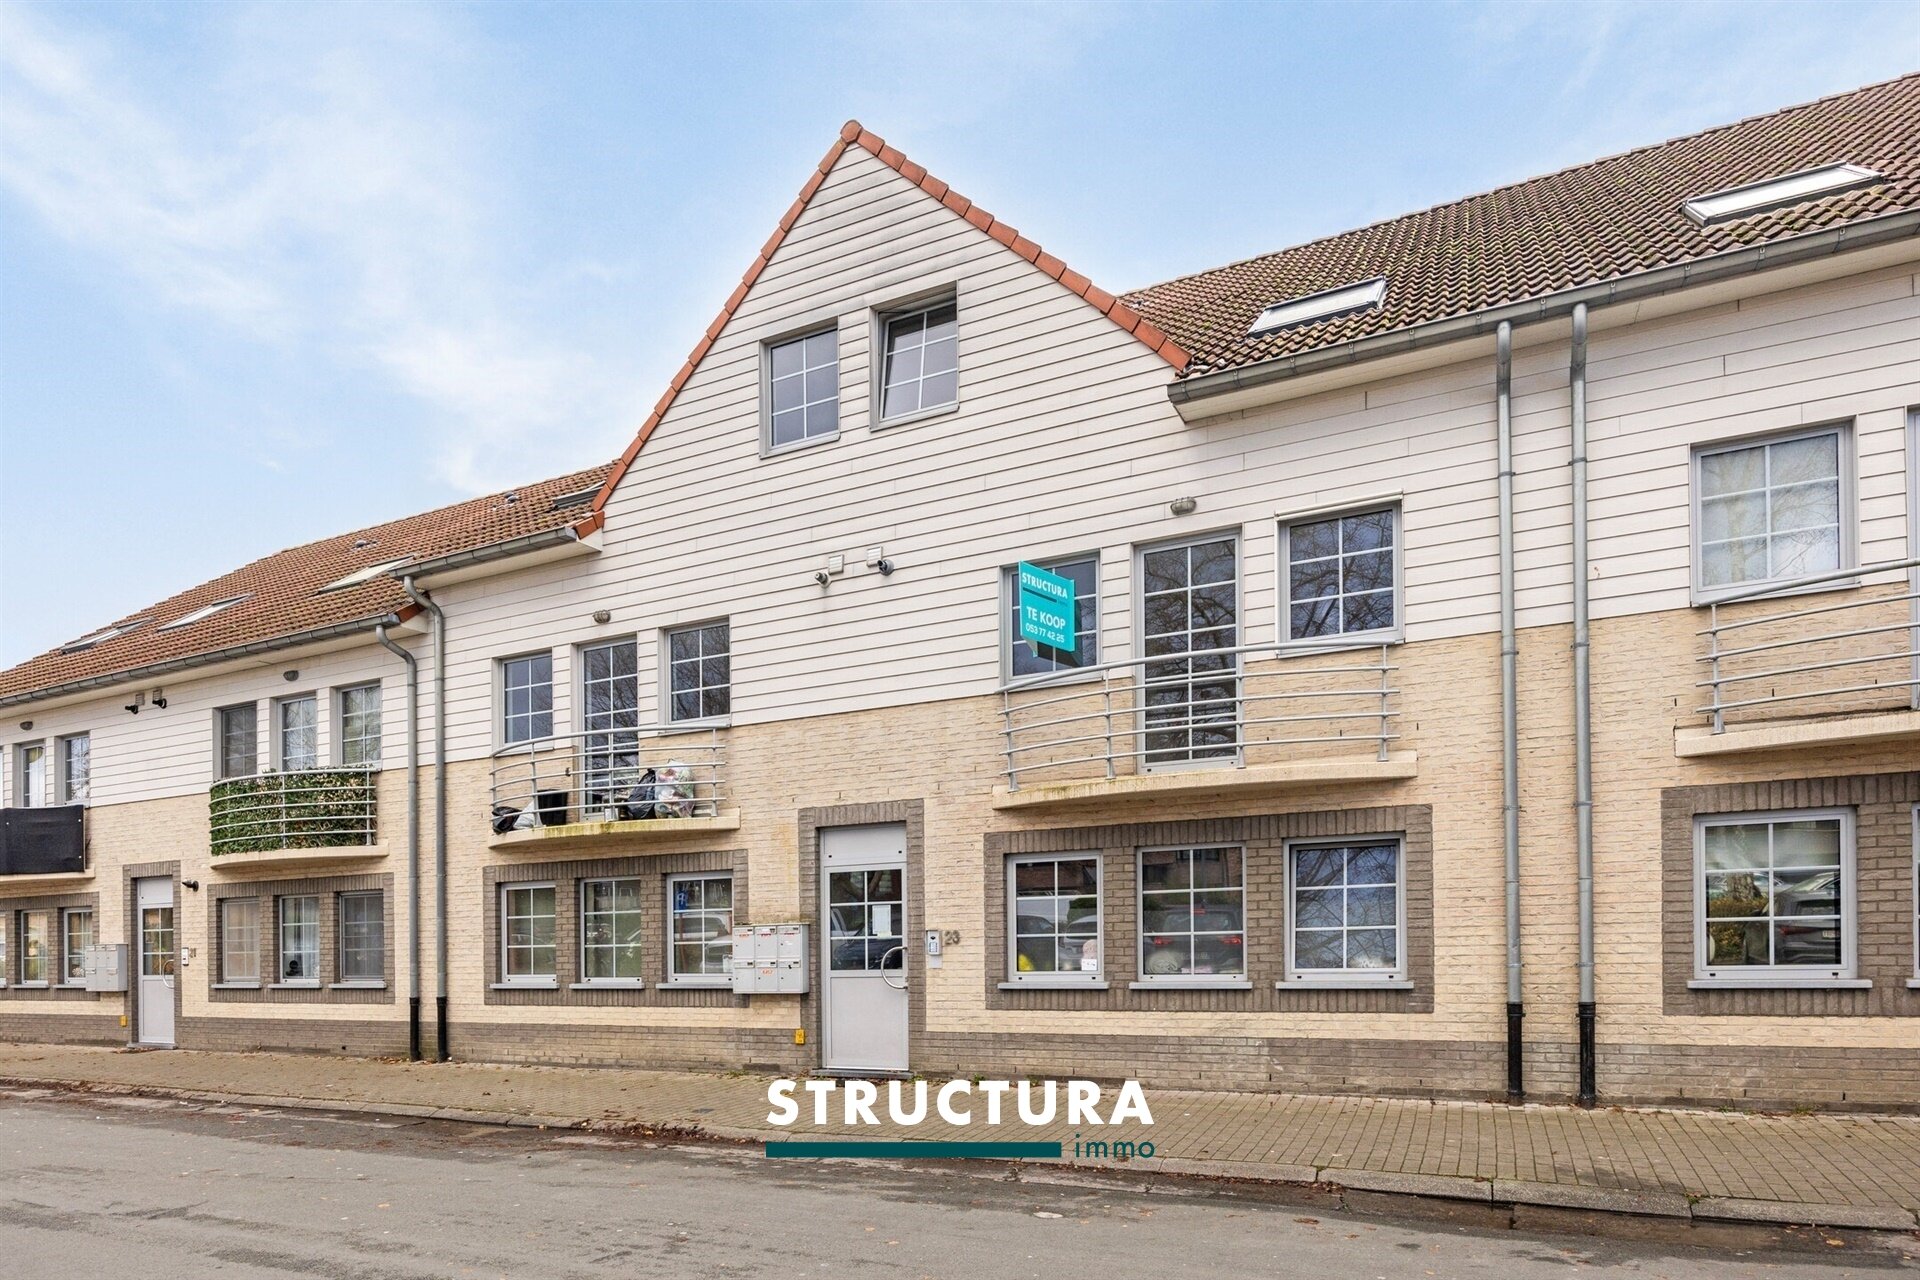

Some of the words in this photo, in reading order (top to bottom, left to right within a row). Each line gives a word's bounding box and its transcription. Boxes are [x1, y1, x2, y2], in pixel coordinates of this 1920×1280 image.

[1022, 572, 1068, 599] STRUCTURA
[1026, 605, 1038, 621] TE
[1040, 611, 1066, 630] KOOP
[1025, 622, 1038, 635] 053
[1039, 627, 1046, 637] 77
[1047, 630, 1056, 641] 42
[1056, 633, 1065, 643] 25
